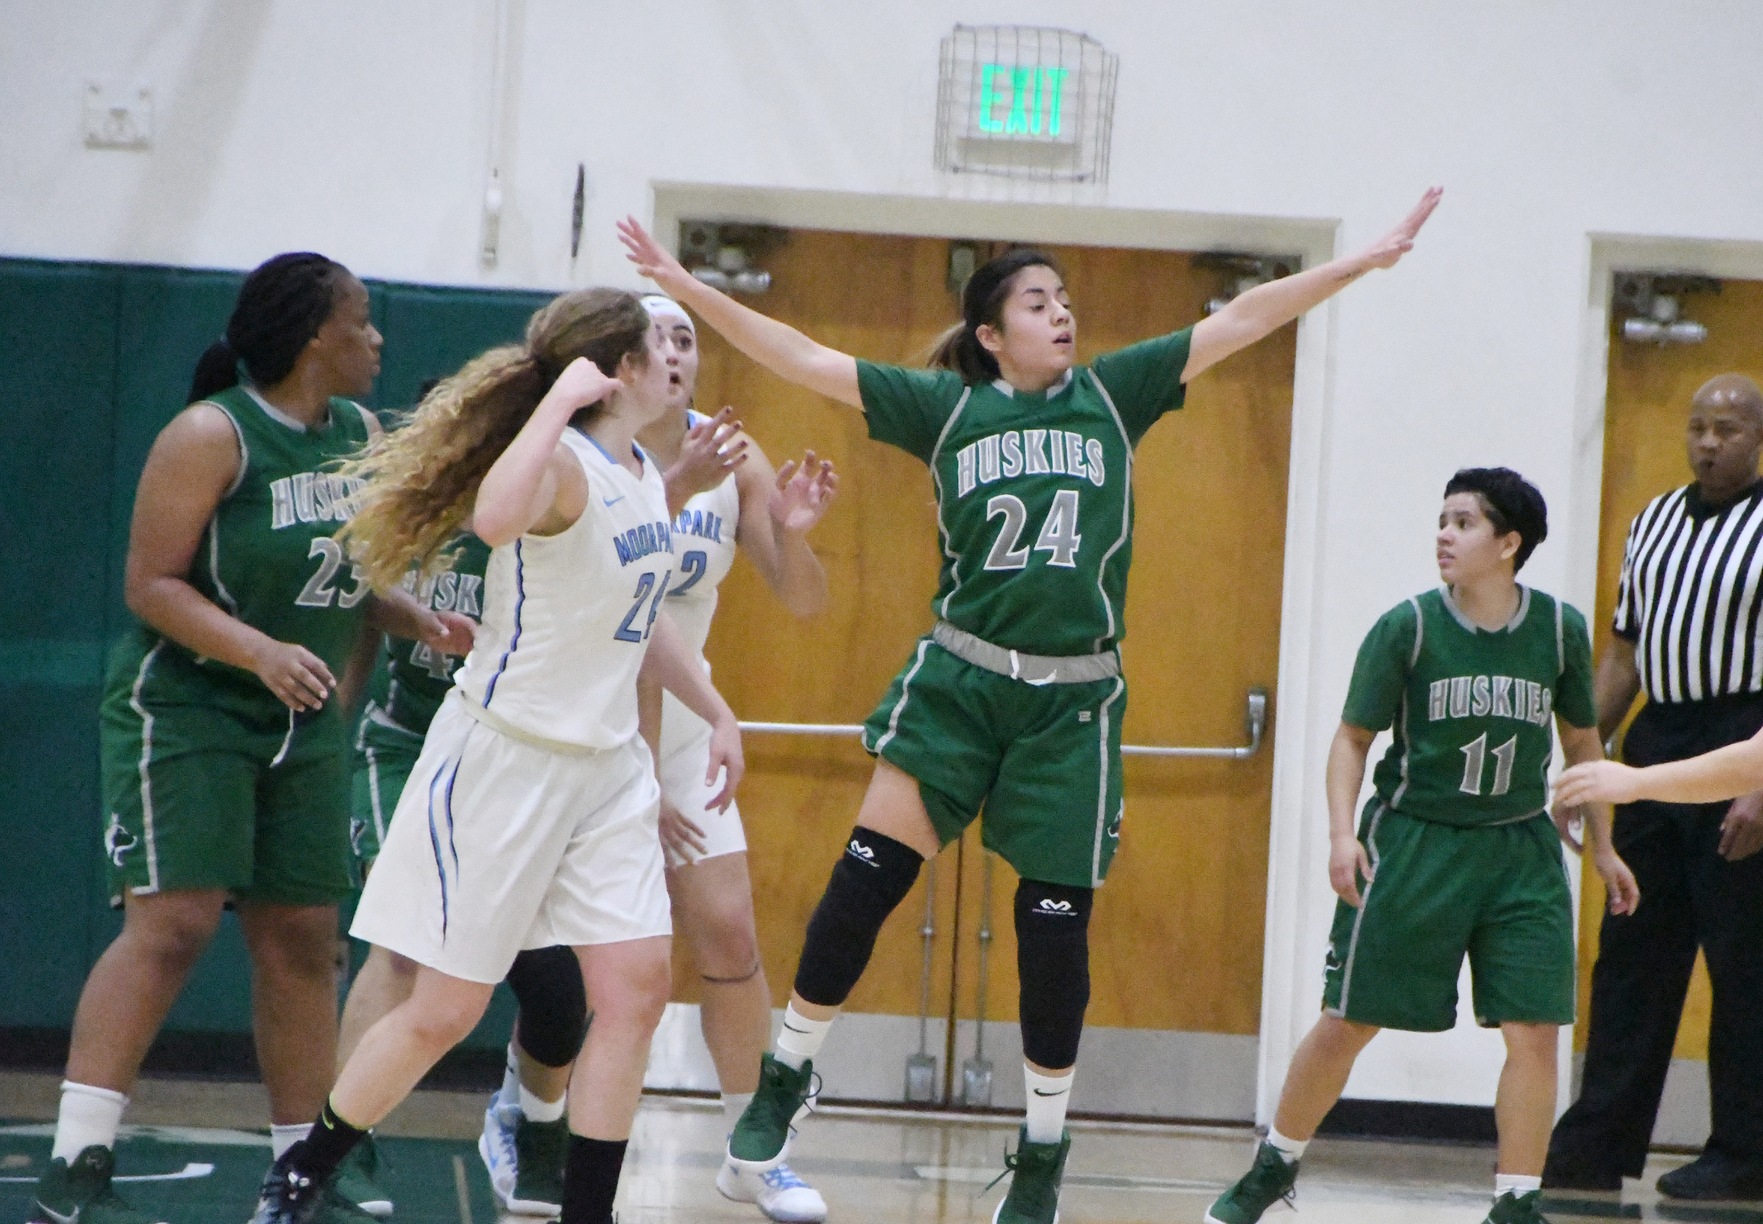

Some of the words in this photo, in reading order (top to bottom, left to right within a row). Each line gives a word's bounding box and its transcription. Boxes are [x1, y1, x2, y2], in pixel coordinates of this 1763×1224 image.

[978, 63, 1069, 137] EXIT
[957, 429, 1105, 498] HUSKIES
[983, 489, 1081, 570] 24
[1429, 675, 1552, 727] HUSKIES
[1459, 731, 1517, 795] 11
